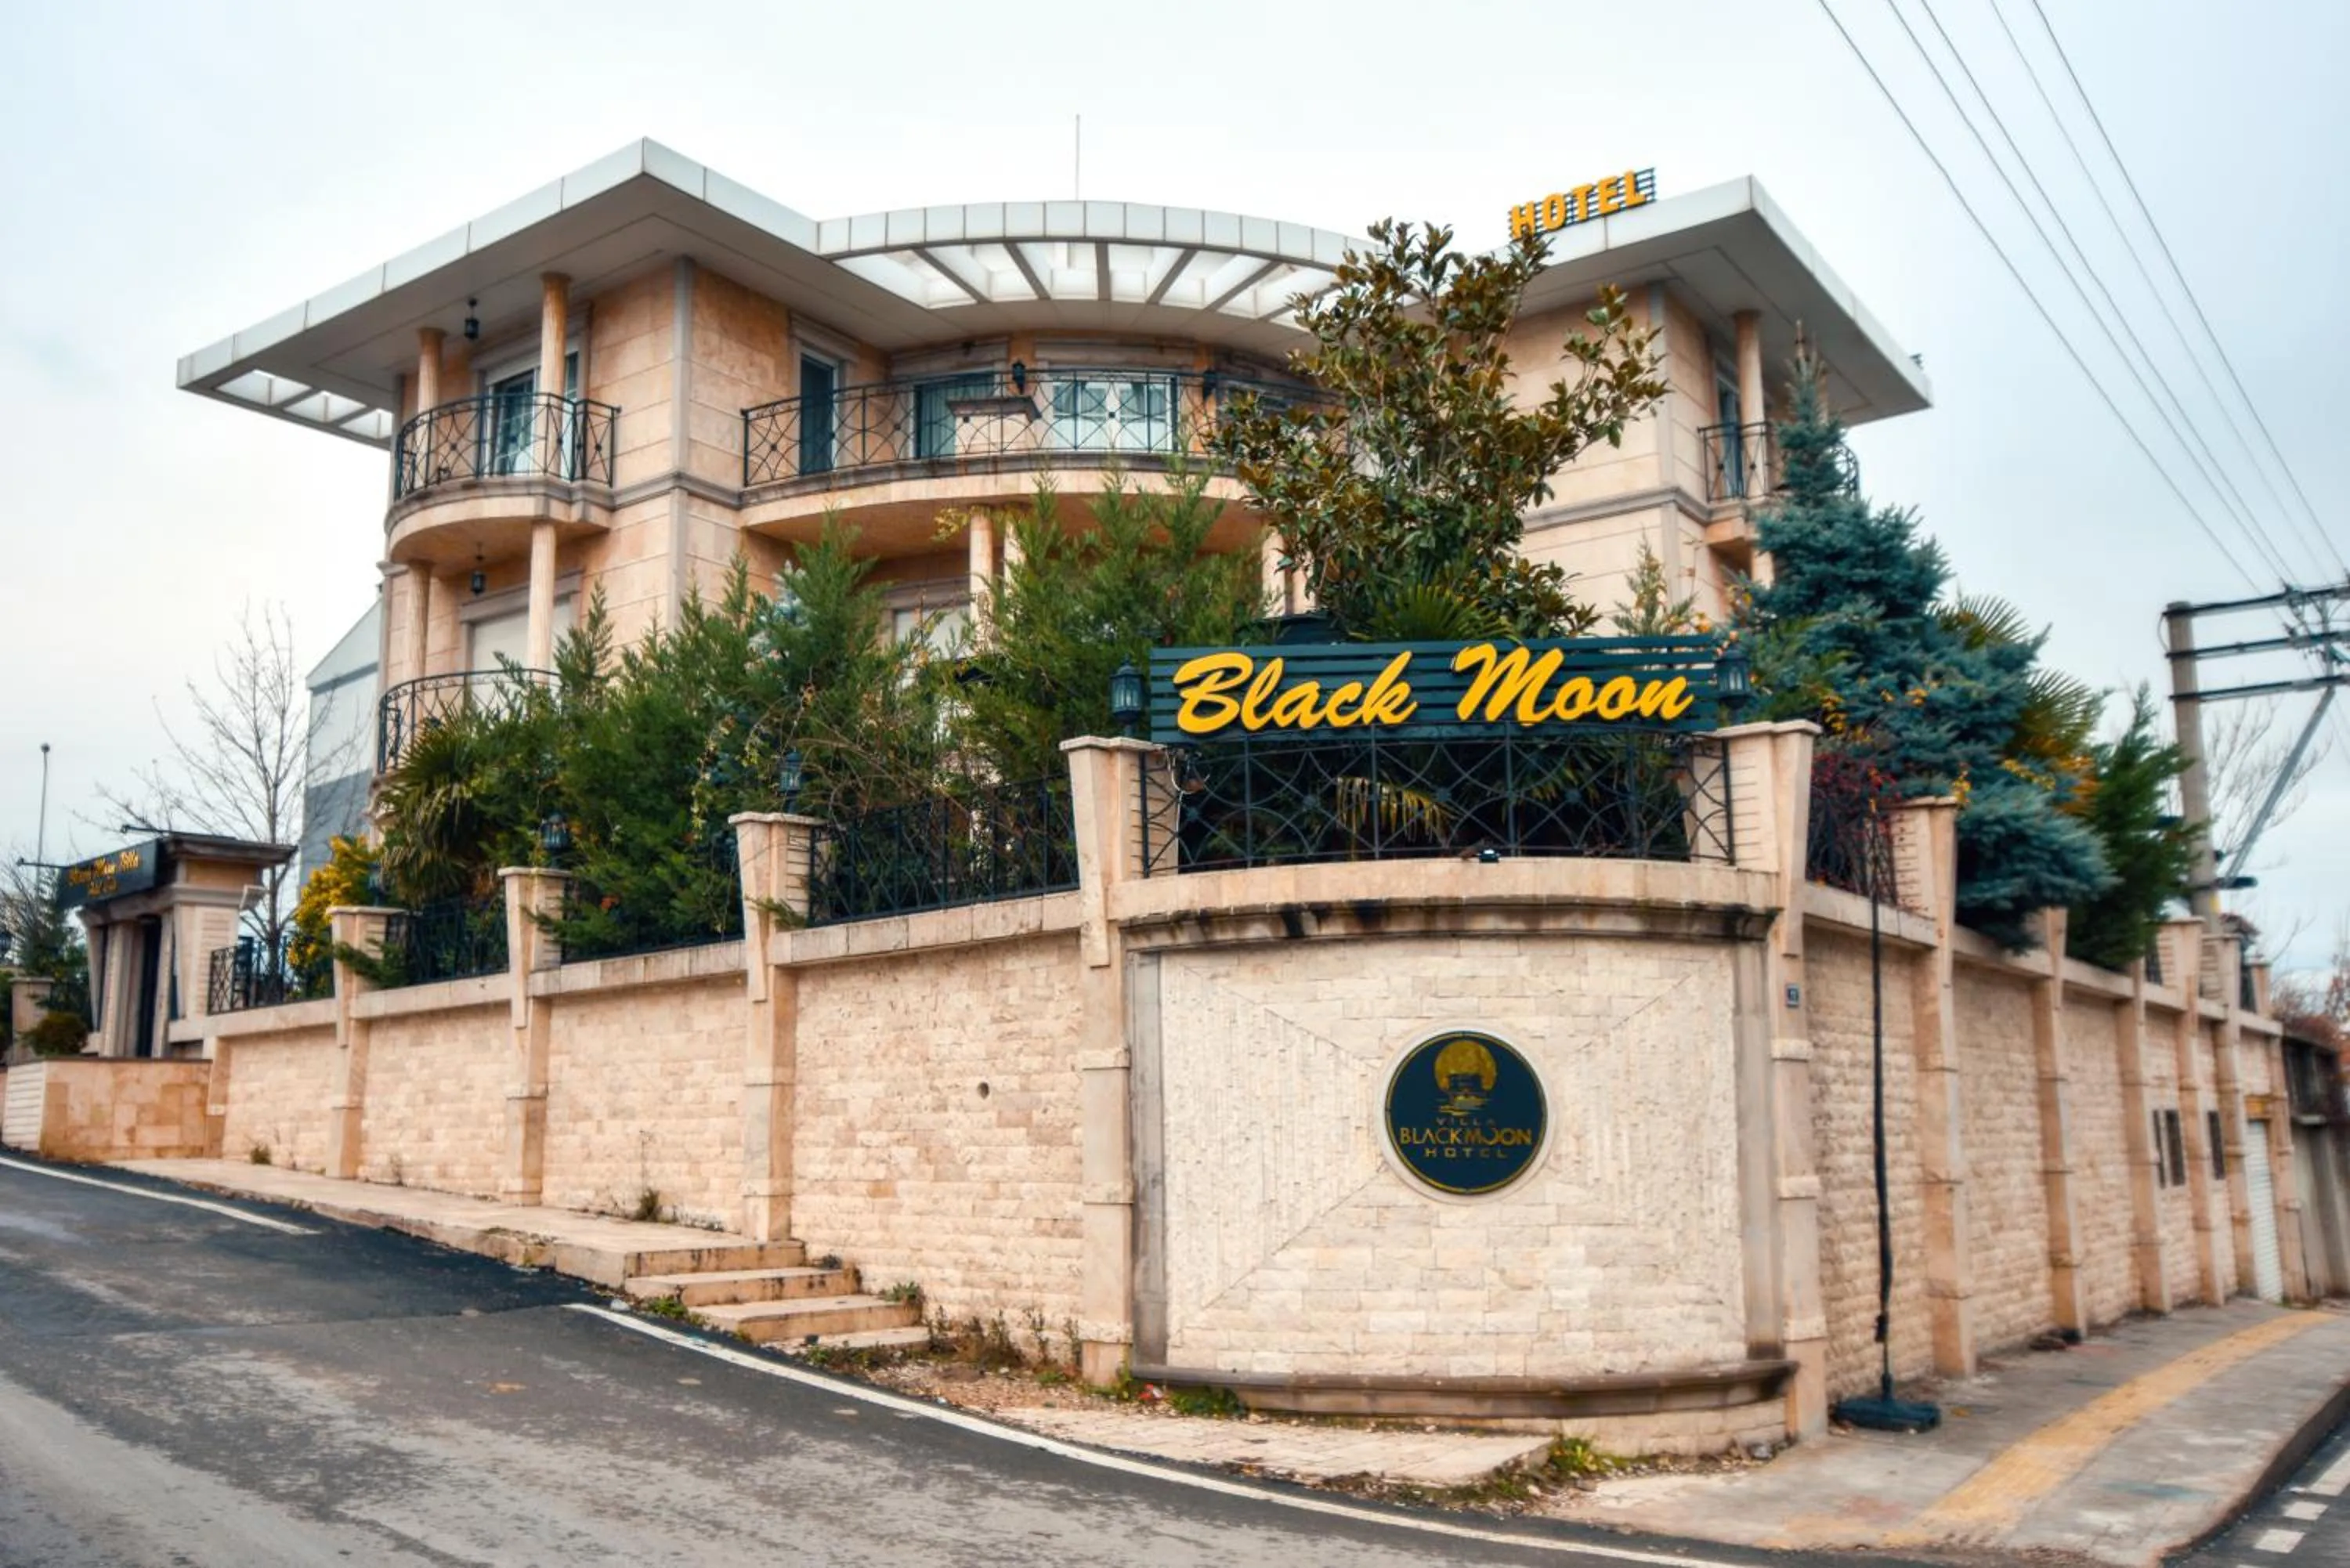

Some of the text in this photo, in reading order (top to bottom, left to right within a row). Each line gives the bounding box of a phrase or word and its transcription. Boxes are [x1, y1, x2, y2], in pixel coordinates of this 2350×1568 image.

[1510, 168, 1646, 239] HOTEL
[1173, 643, 1694, 734] Black Moon
